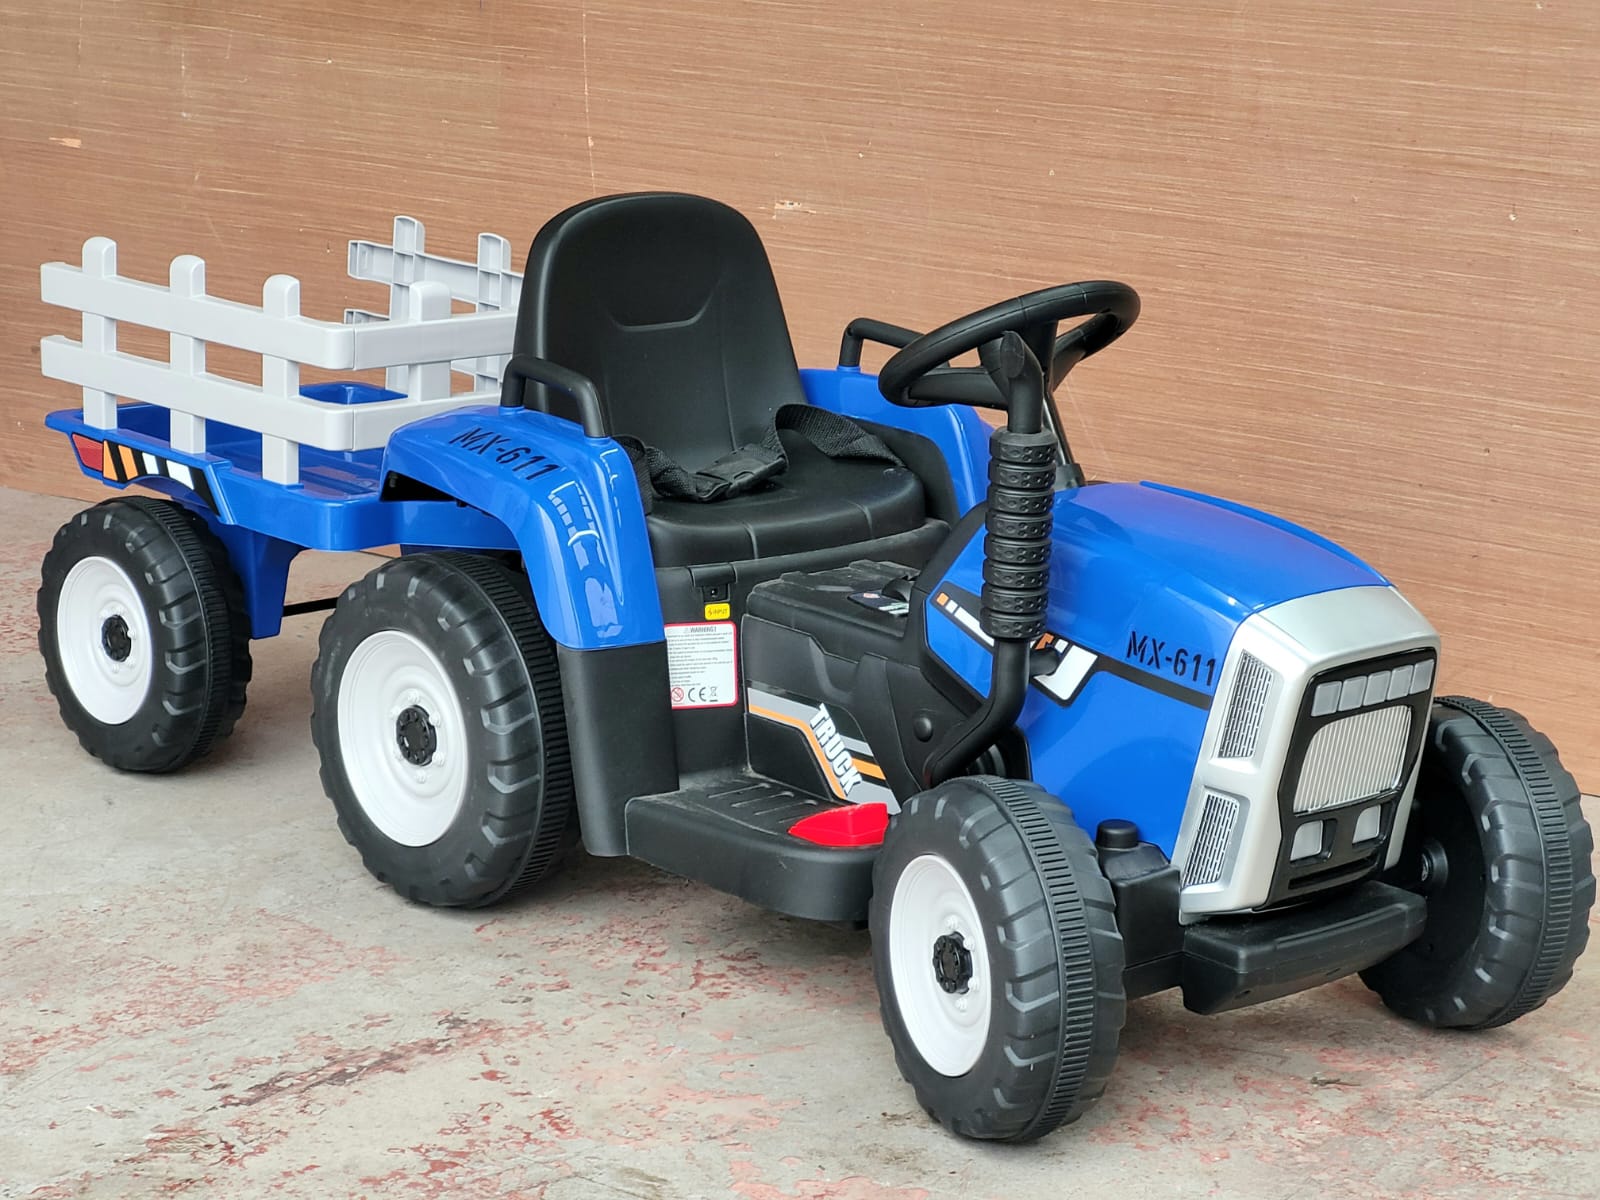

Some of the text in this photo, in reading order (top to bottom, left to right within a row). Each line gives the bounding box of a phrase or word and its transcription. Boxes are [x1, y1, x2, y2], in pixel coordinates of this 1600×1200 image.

[449, 427, 560, 481] MX-611
[1126, 630, 1216, 687] MX-611
[809, 702, 863, 797] TRUCK
